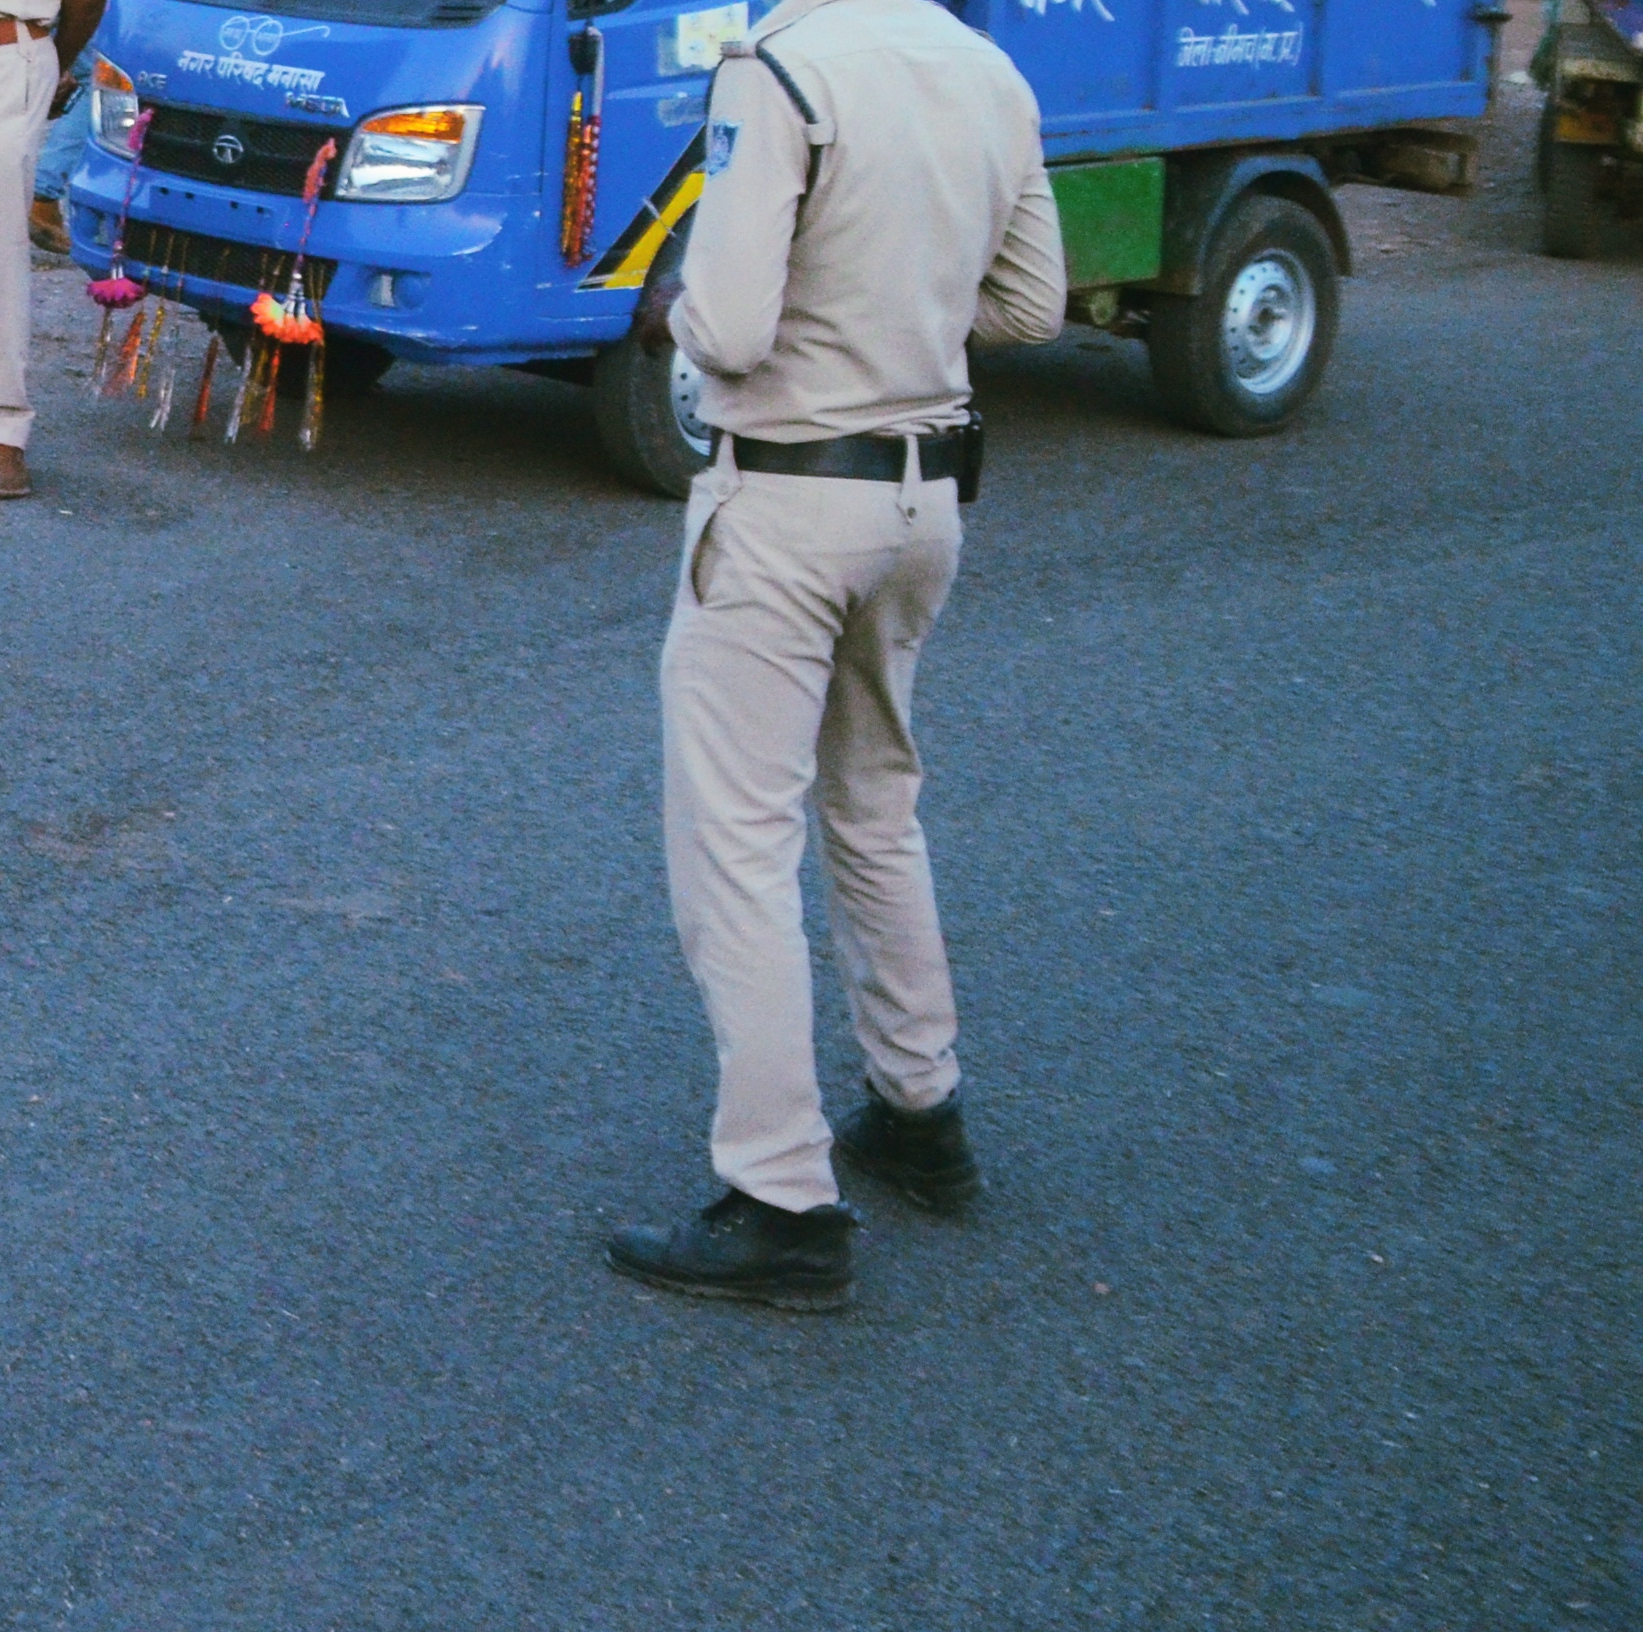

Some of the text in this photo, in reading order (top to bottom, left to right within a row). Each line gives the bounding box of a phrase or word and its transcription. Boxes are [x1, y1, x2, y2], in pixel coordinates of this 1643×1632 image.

[177, 49, 326, 91] नगर परिषद मनासा
